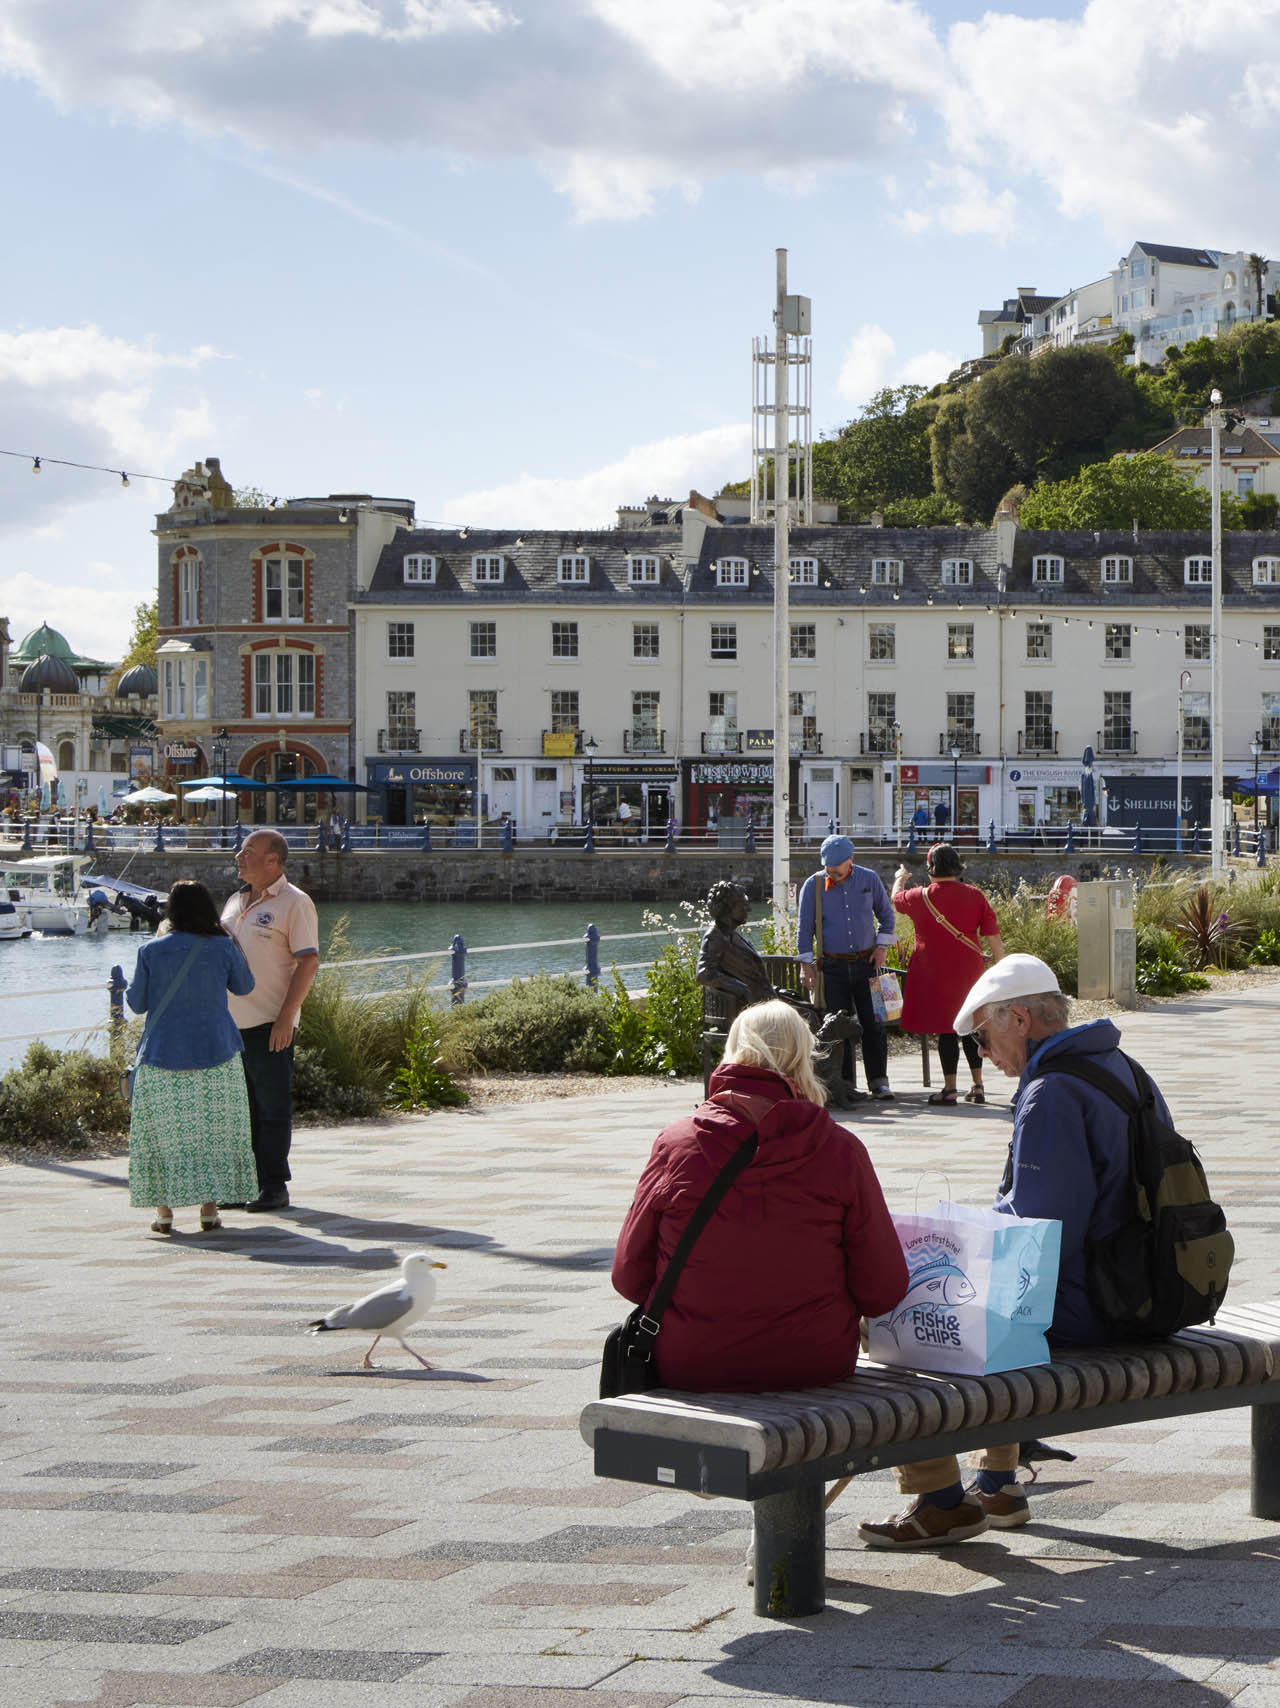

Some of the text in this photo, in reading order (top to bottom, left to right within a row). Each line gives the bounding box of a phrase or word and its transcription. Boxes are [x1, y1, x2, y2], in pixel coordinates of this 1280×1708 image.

[164, 744, 198, 758] Offshore
[409, 768, 465, 781] Offshore
[905, 1236, 923, 1250] Love
[924, 1234, 931, 1243] at
[932, 1233, 946, 1245] first
[915, 1327, 961, 1346] CHIPS
